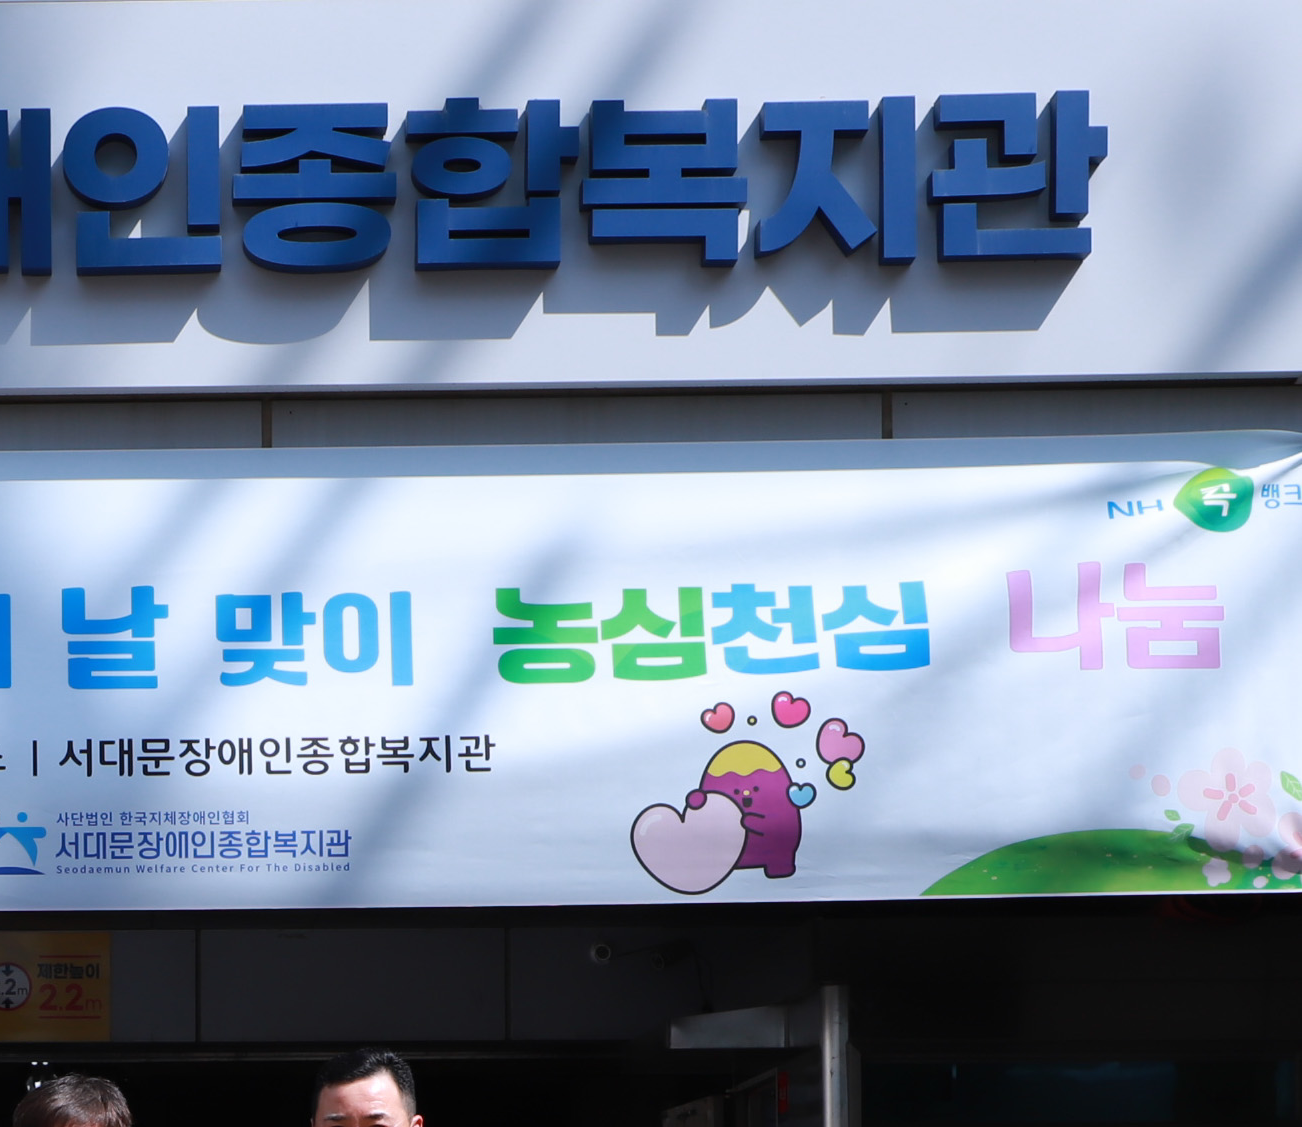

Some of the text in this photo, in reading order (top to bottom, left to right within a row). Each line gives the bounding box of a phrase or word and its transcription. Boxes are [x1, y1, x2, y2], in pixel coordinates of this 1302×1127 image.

[1261, 484, 1302, 509] 뱅크
[1107, 499, 1164, 520] NH
[60, 584, 169, 690] 날
[214, 589, 415, 688] 맞이
[492, 580, 931, 685] 농심천심
[1005, 561, 1225, 671] 나눔
[58, 734, 496, 779] 서대문장애인종합복지관
[56, 811, 250, 826] 사단법인 한국지체장애인협회
[55, 830, 352, 860] 서대문장애인종합복지관
[56, 862, 351, 874] Seodaemun Welfare Center For The Disabled
[37, 963, 100, 979] 제한높이
[39, 983, 102, 1012] 2.2m
